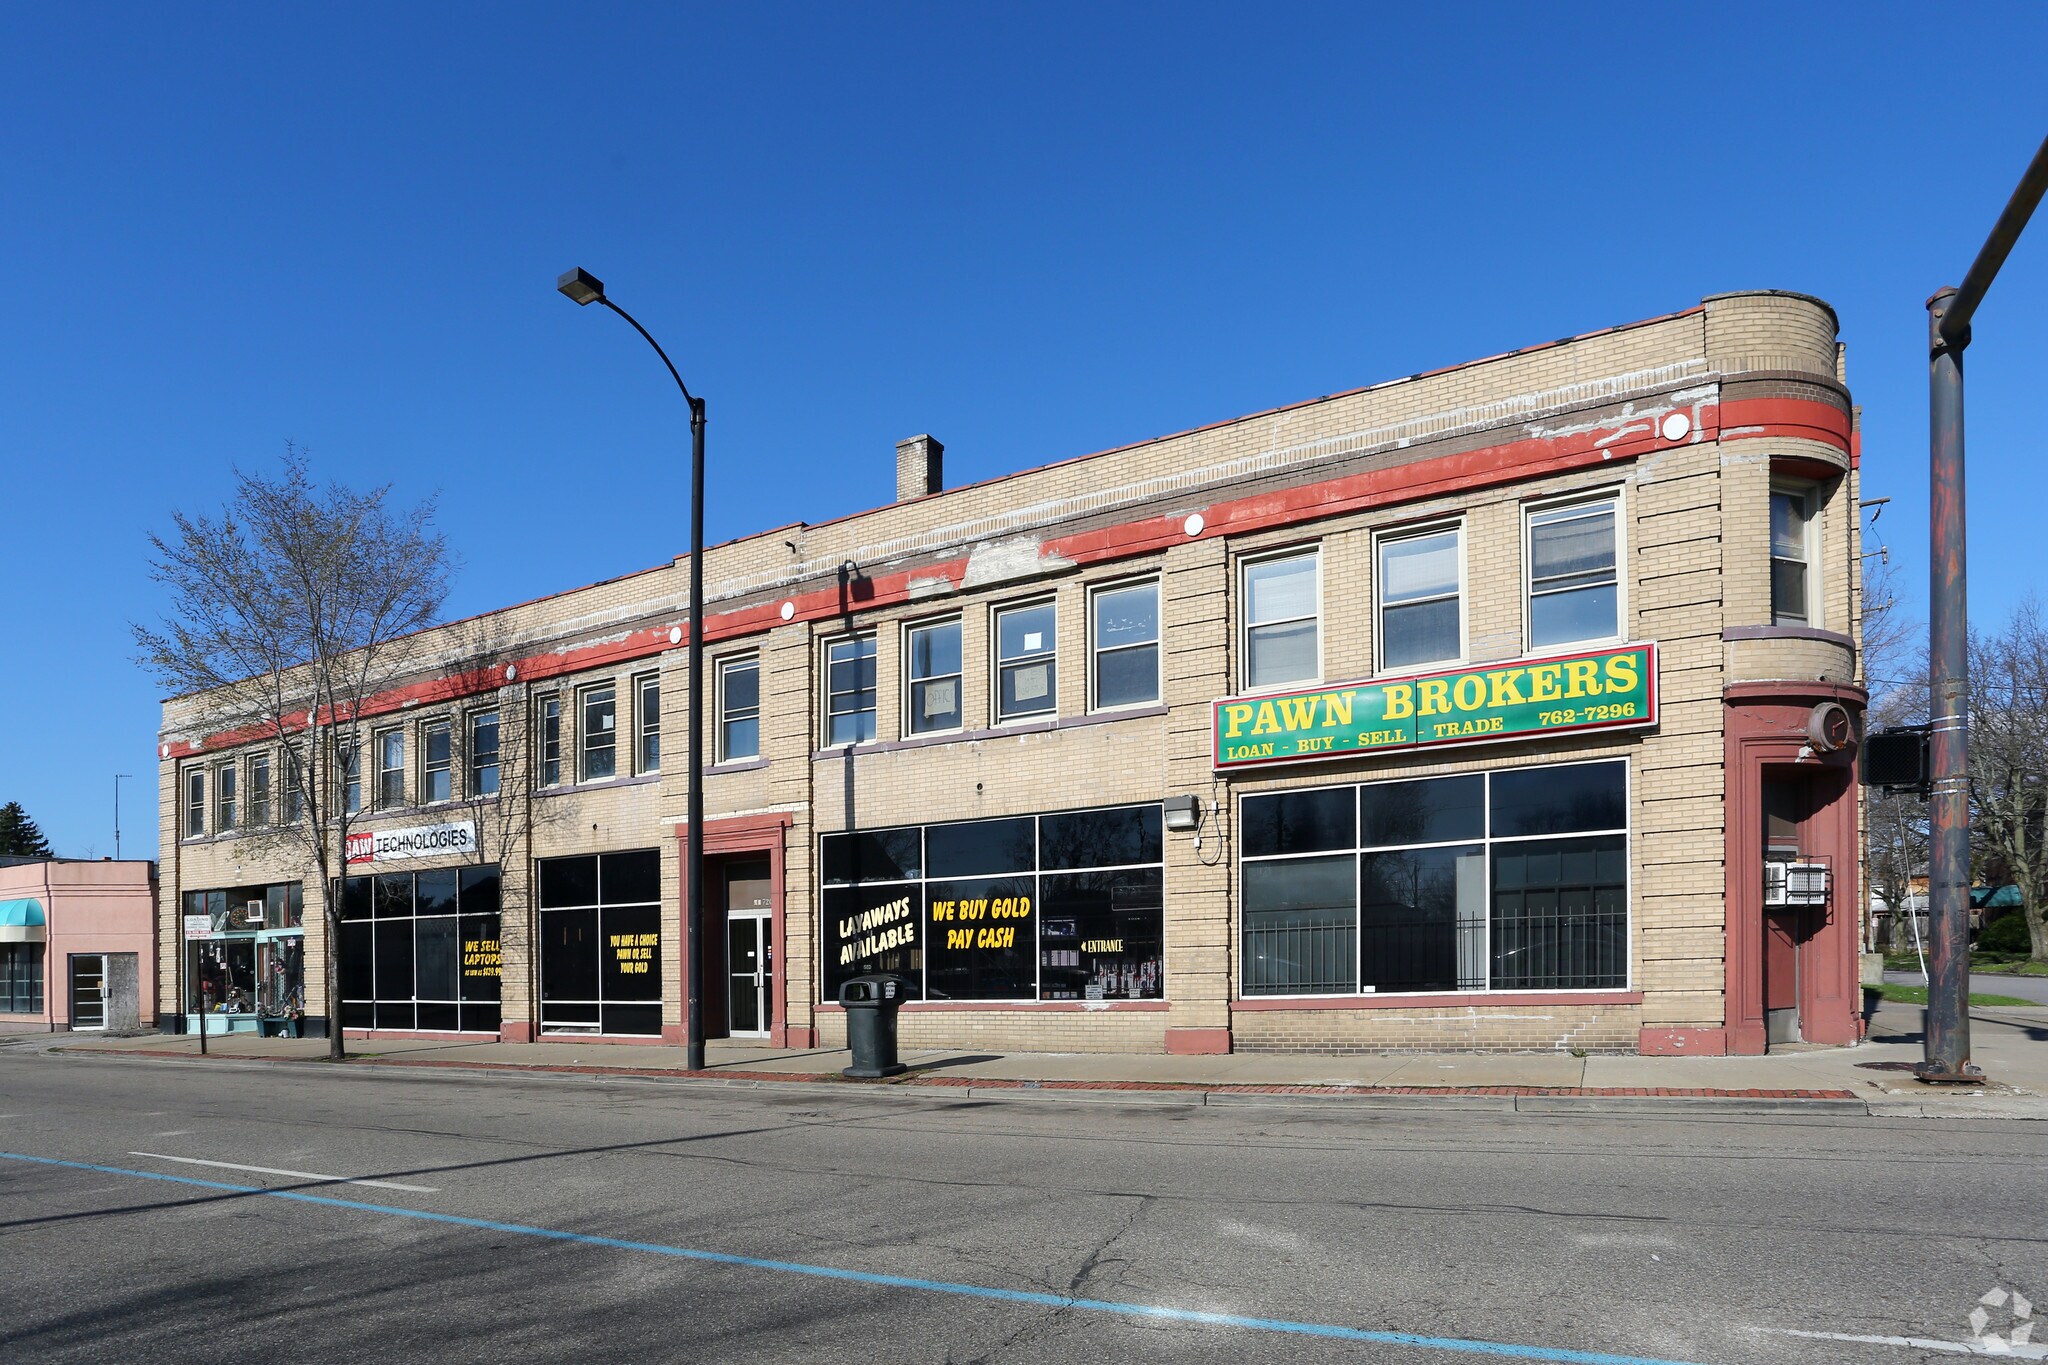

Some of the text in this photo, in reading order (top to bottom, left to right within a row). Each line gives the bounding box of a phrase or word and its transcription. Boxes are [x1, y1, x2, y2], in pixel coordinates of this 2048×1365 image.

[1225, 654, 1638, 738] PAWN BROKERS
[1538, 702, 1636, 726] 762-7296
[1227, 742, 1274, 760] LOAN
[1297, 736, 1335, 752] BUY
[1358, 729, 1407, 746] SELL
[1433, 717, 1504, 738] TRADE
[376, 828, 467, 853] TECHNOLOGIES
[839, 896, 910, 939] LAYAWAYS
[932, 896, 1030, 921] WE BUY GOLD
[465, 940, 500, 953] WE SELL
[610, 933, 658, 947] YOU HAVE A CHOICE
[839, 922, 915, 965] AVAILABLE
[946, 927, 1015, 950] PAY CASH
[1087, 939, 1124, 953] ENTRANCE
[464, 953, 501, 965] LAPTOPS
[616, 947, 652, 960] PAWN OR SELL
[620, 961, 649, 974] YOUR GOLD
